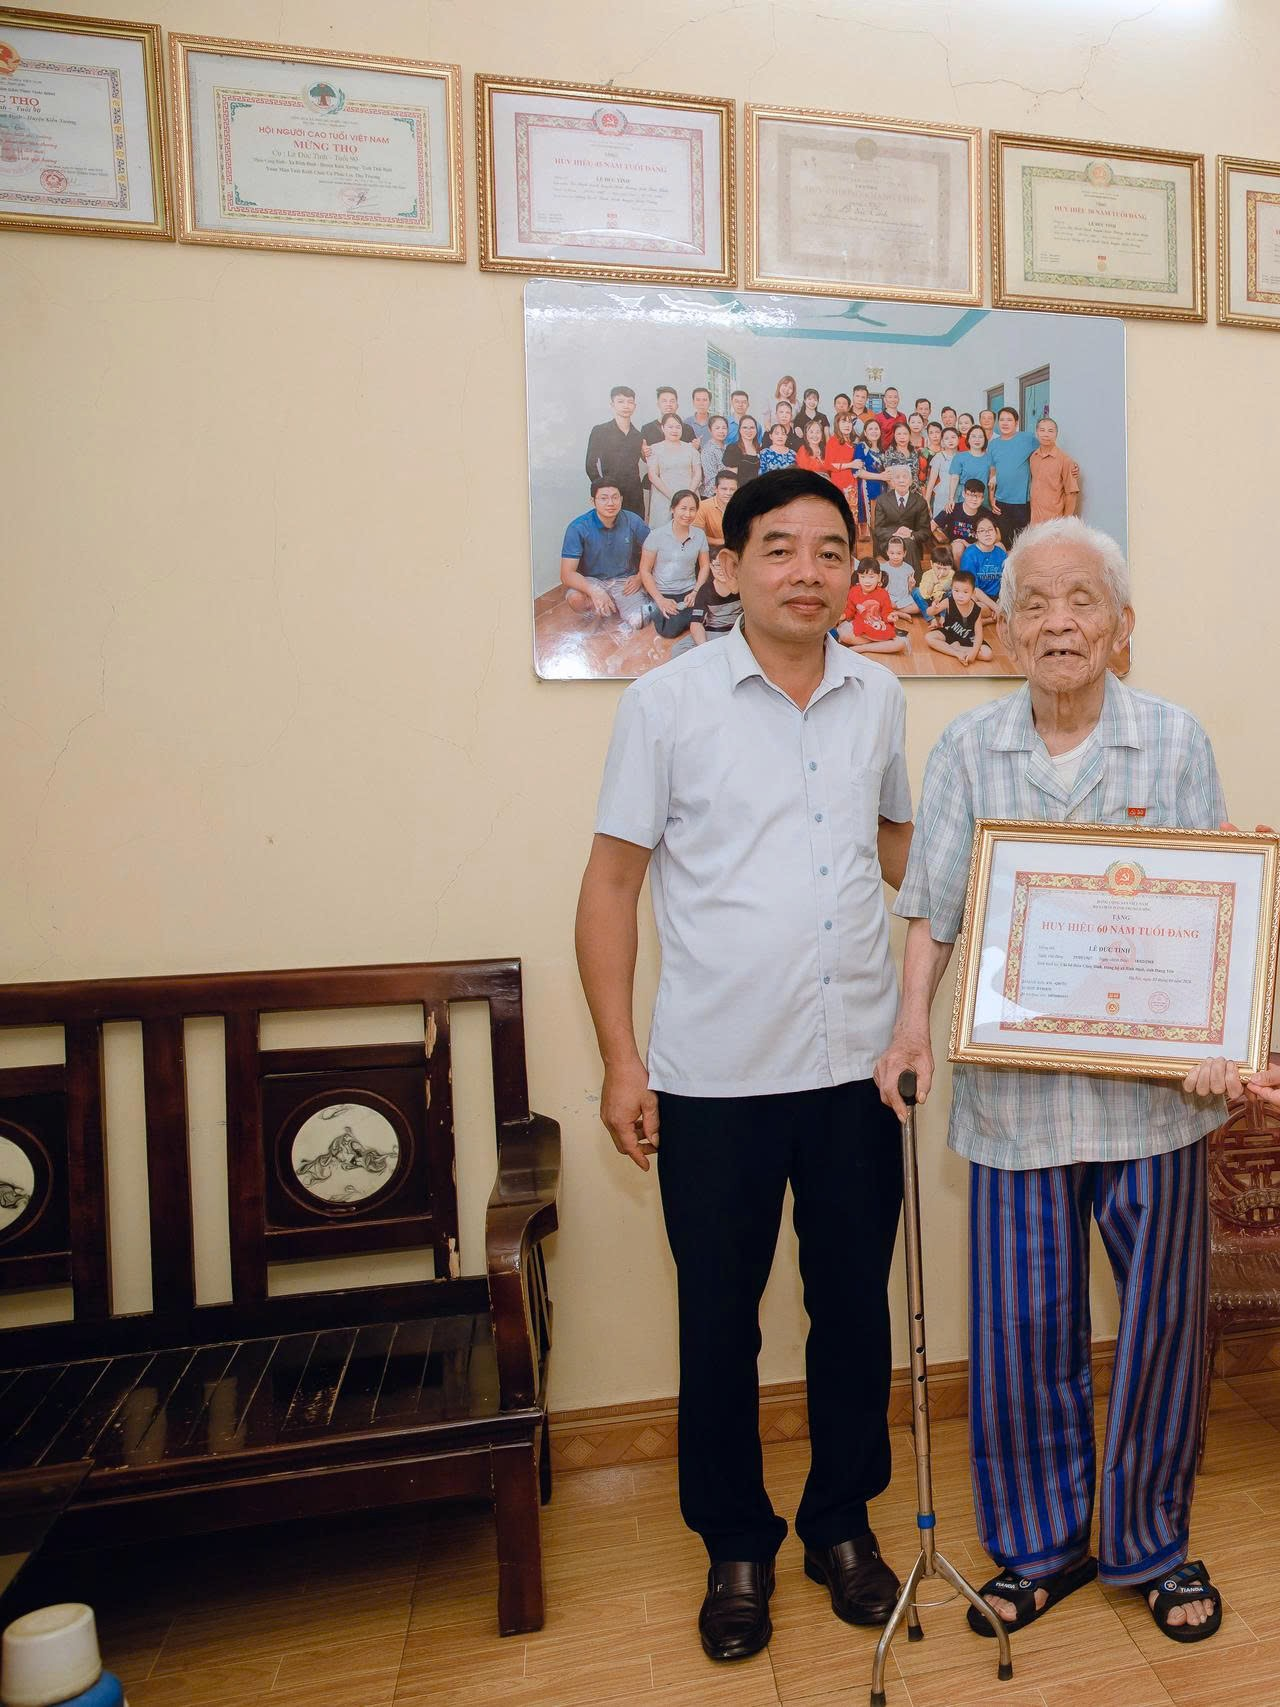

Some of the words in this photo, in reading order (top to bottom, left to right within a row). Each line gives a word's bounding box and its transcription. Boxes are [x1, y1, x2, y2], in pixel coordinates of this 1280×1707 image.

[10, 95, 40, 107] THỌ
[276, 127, 305, 137] NGƯỜI
[307, 130, 327, 139] CAO
[329, 131, 348, 141] TUỔI
[369, 135, 390, 144] NAM
[332, 143, 358, 155] THỌ
[1041, 920, 1065, 931] HUY
[1097, 924, 1108, 934] 60
[1110, 924, 1135, 936] NĂM
[1139, 925, 1165, 937] TUỔI
[1167, 926, 1200, 939] ĐẢNG
